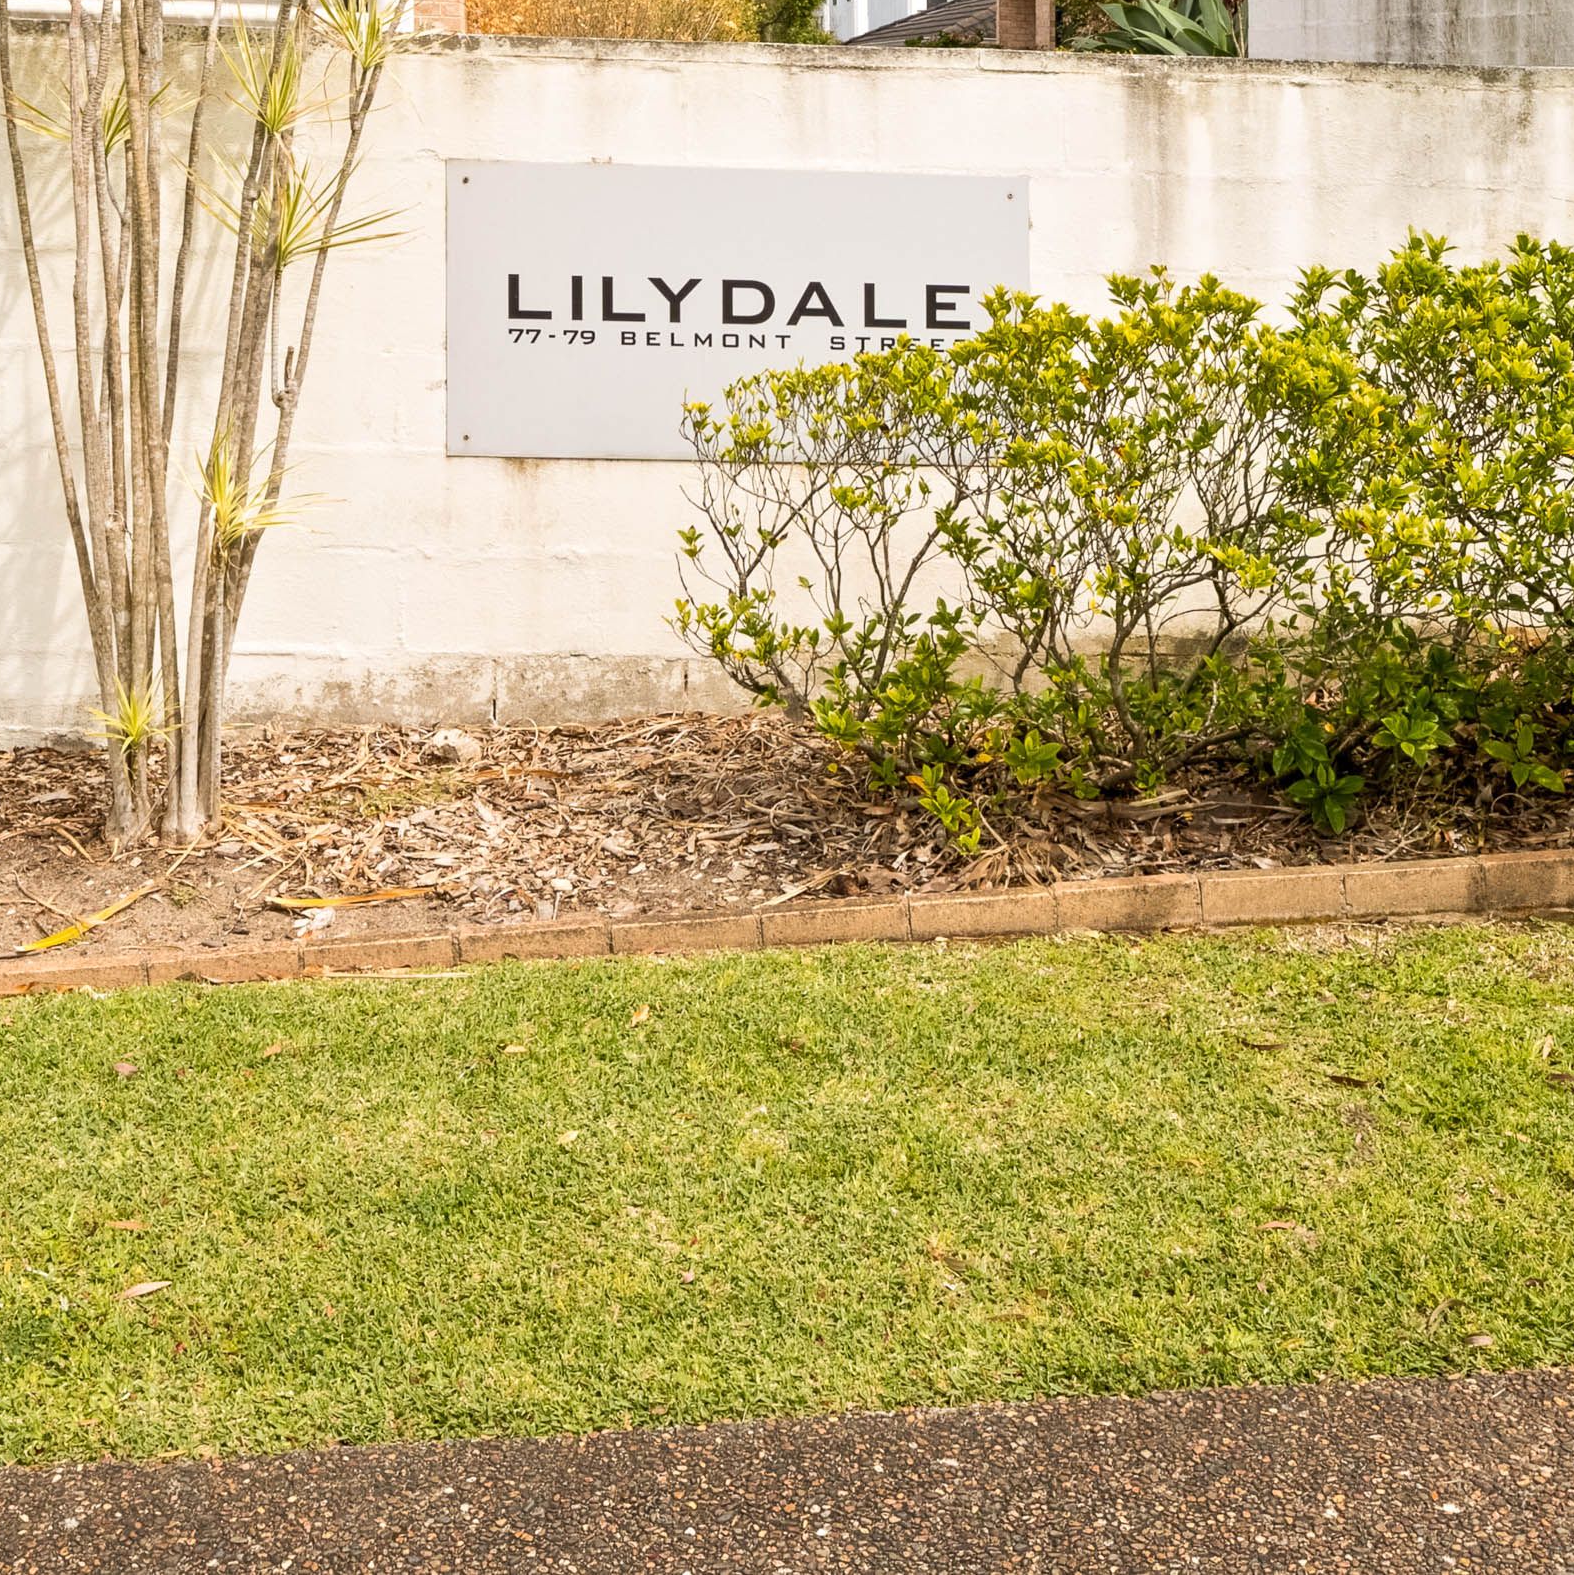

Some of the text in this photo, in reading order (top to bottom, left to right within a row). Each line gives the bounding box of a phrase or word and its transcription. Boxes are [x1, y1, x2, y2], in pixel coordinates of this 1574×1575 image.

[508, 274, 971, 330] LILYDALE
[508, 328, 596, 345] 77-79
[620, 331, 791, 349] BELMONT
